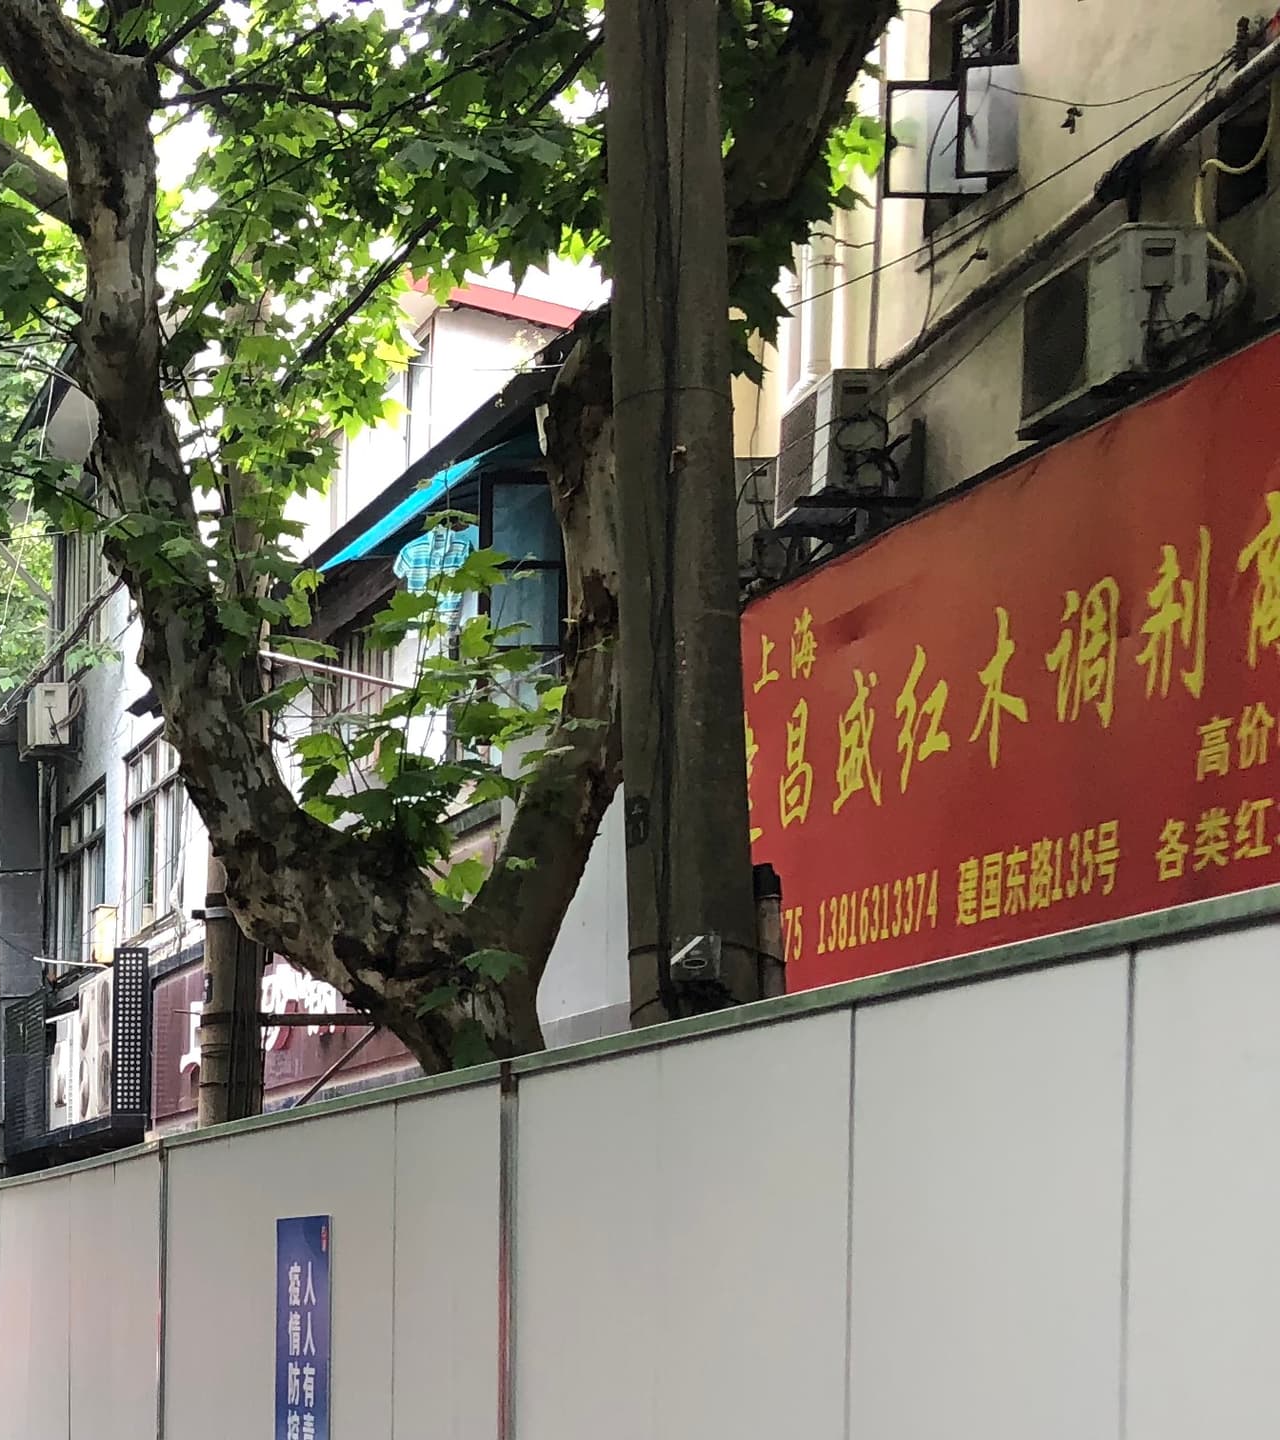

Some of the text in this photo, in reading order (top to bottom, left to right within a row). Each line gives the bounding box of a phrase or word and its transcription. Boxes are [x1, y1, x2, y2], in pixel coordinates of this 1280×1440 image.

[753, 606, 817, 694] 上海
[1196, 700, 1280, 782] 高价
[780, 797, 1280, 963] 75 13816313374 建国东路135号 各类红
